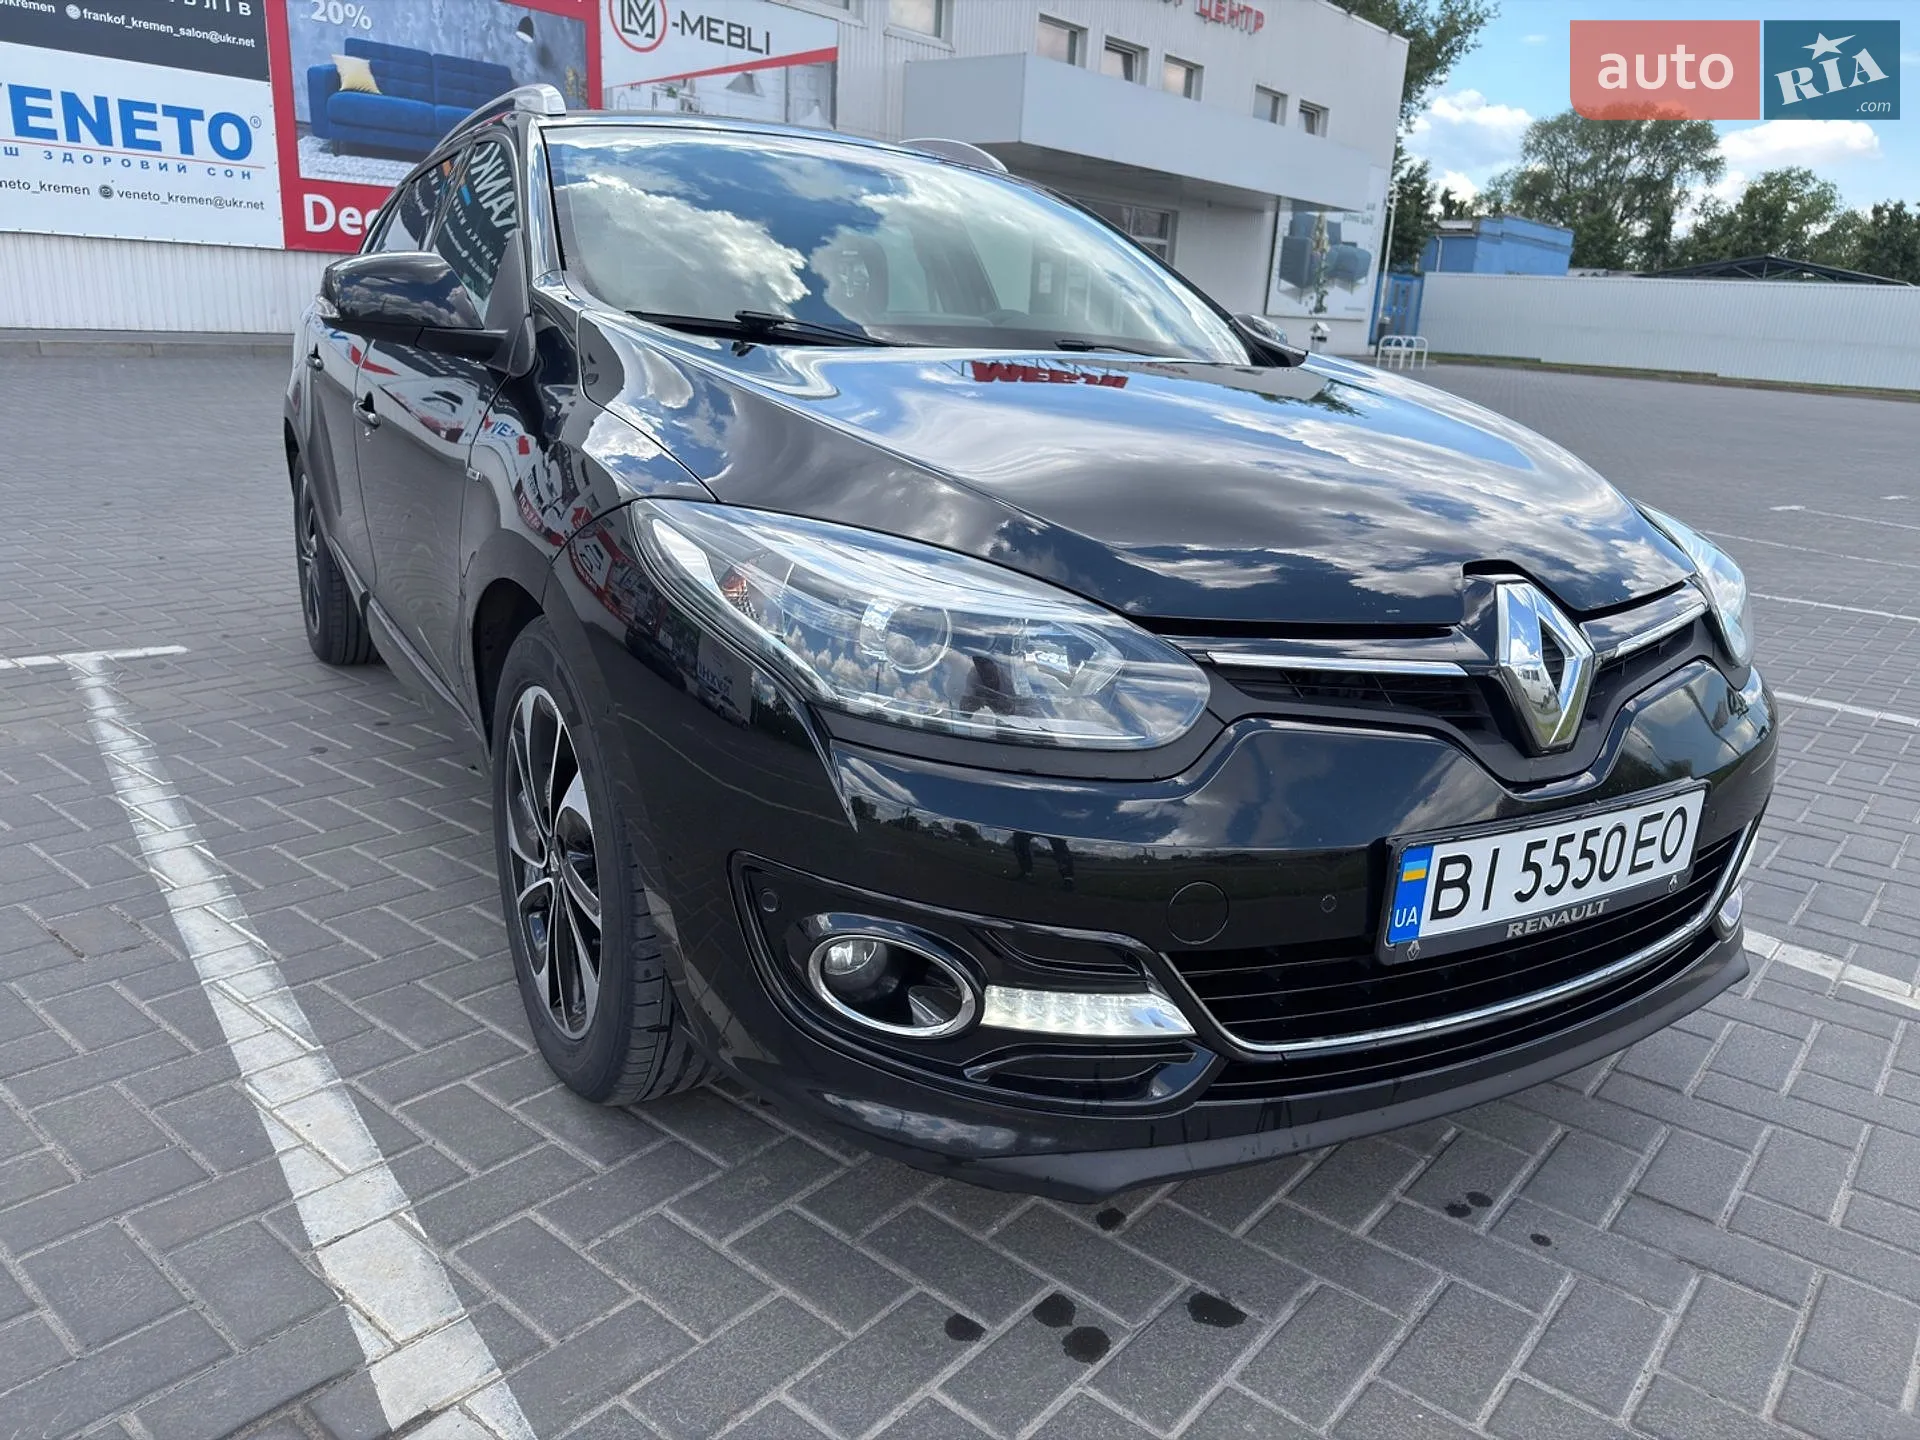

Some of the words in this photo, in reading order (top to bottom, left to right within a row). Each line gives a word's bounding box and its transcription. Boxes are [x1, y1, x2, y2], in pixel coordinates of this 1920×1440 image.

[0, 83, 253, 161] ENETO
[207, 166, 251, 180] СОН
[117, 188, 265, 210] veneto_kremen@ukr.net
[1429, 847, 1500, 921] BI
[1394, 906, 1418, 929] UA
[1506, 899, 1611, 939] RENAULT
